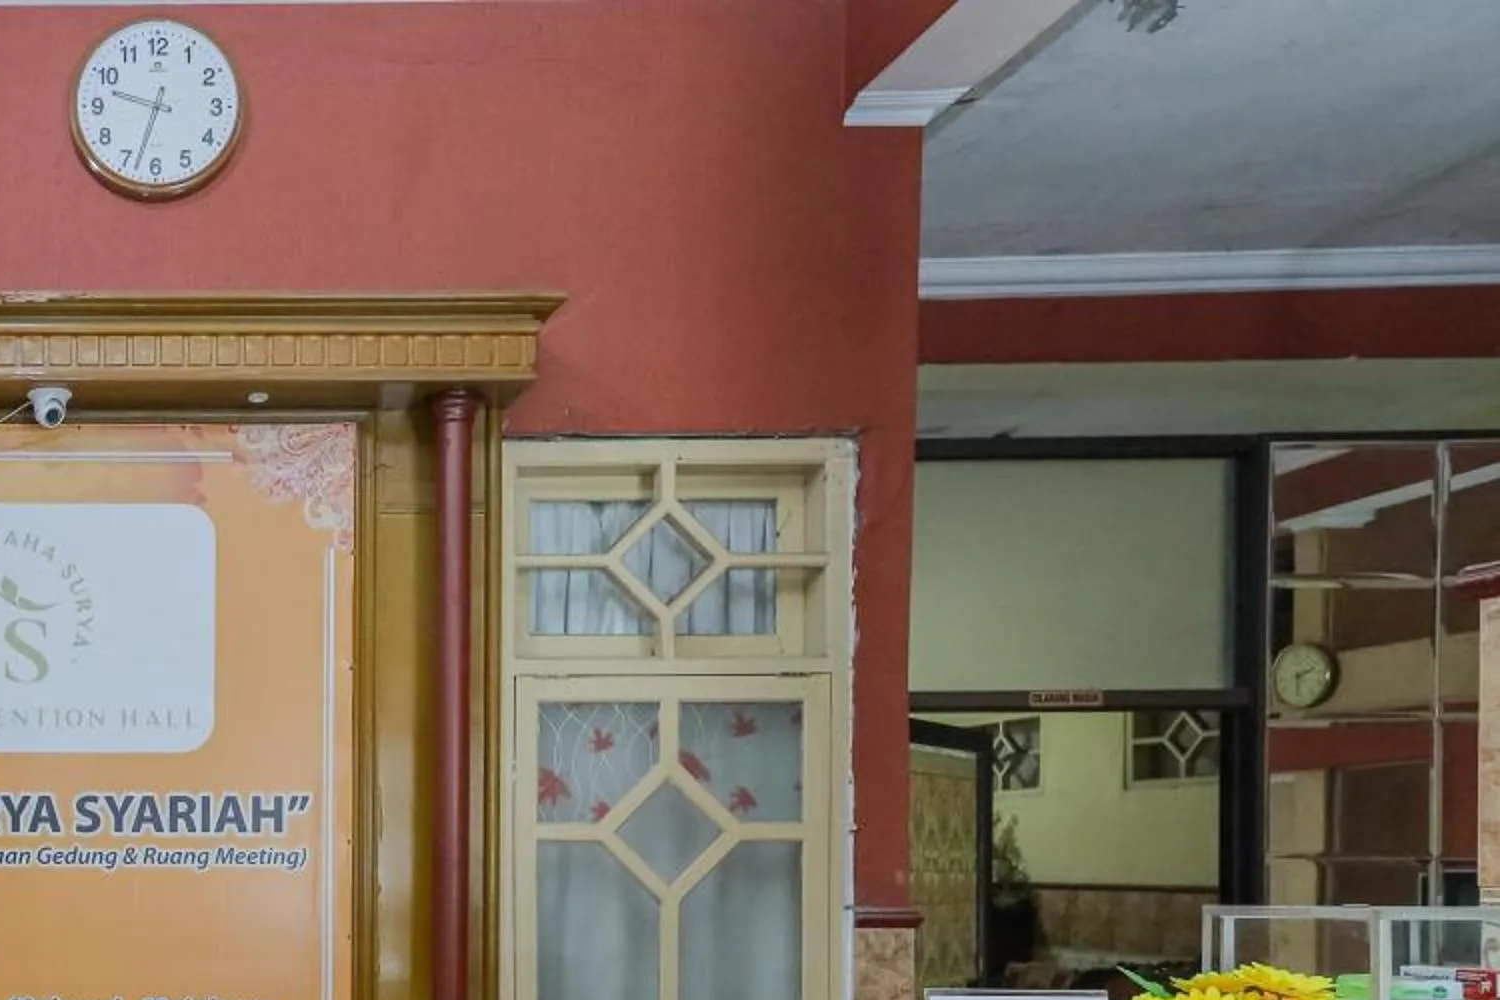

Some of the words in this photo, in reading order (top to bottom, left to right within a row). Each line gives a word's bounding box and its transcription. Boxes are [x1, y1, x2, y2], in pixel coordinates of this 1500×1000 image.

[120, 45, 137, 63] 11
[148, 37, 169, 57] 12
[184, 46, 192, 64] 1
[99, 67, 119, 85] 10
[203, 67, 216, 86] 2
[91, 97, 104, 115] 9
[210, 98, 223, 116] 3
[99, 127, 111, 145] 8
[201, 128, 214, 146] 4
[120, 149, 133, 167] 7
[150, 157, 162, 176] 6
[179, 149, 192, 168] 5
[60, 562, 95, 648] SURYA
[120, 706, 200, 729] HALL
[37, 845, 117, 869] Gedung
[123, 847, 138, 866] &
[143, 846, 210, 869] Ruang
[215, 847, 308, 869] Meeting)
